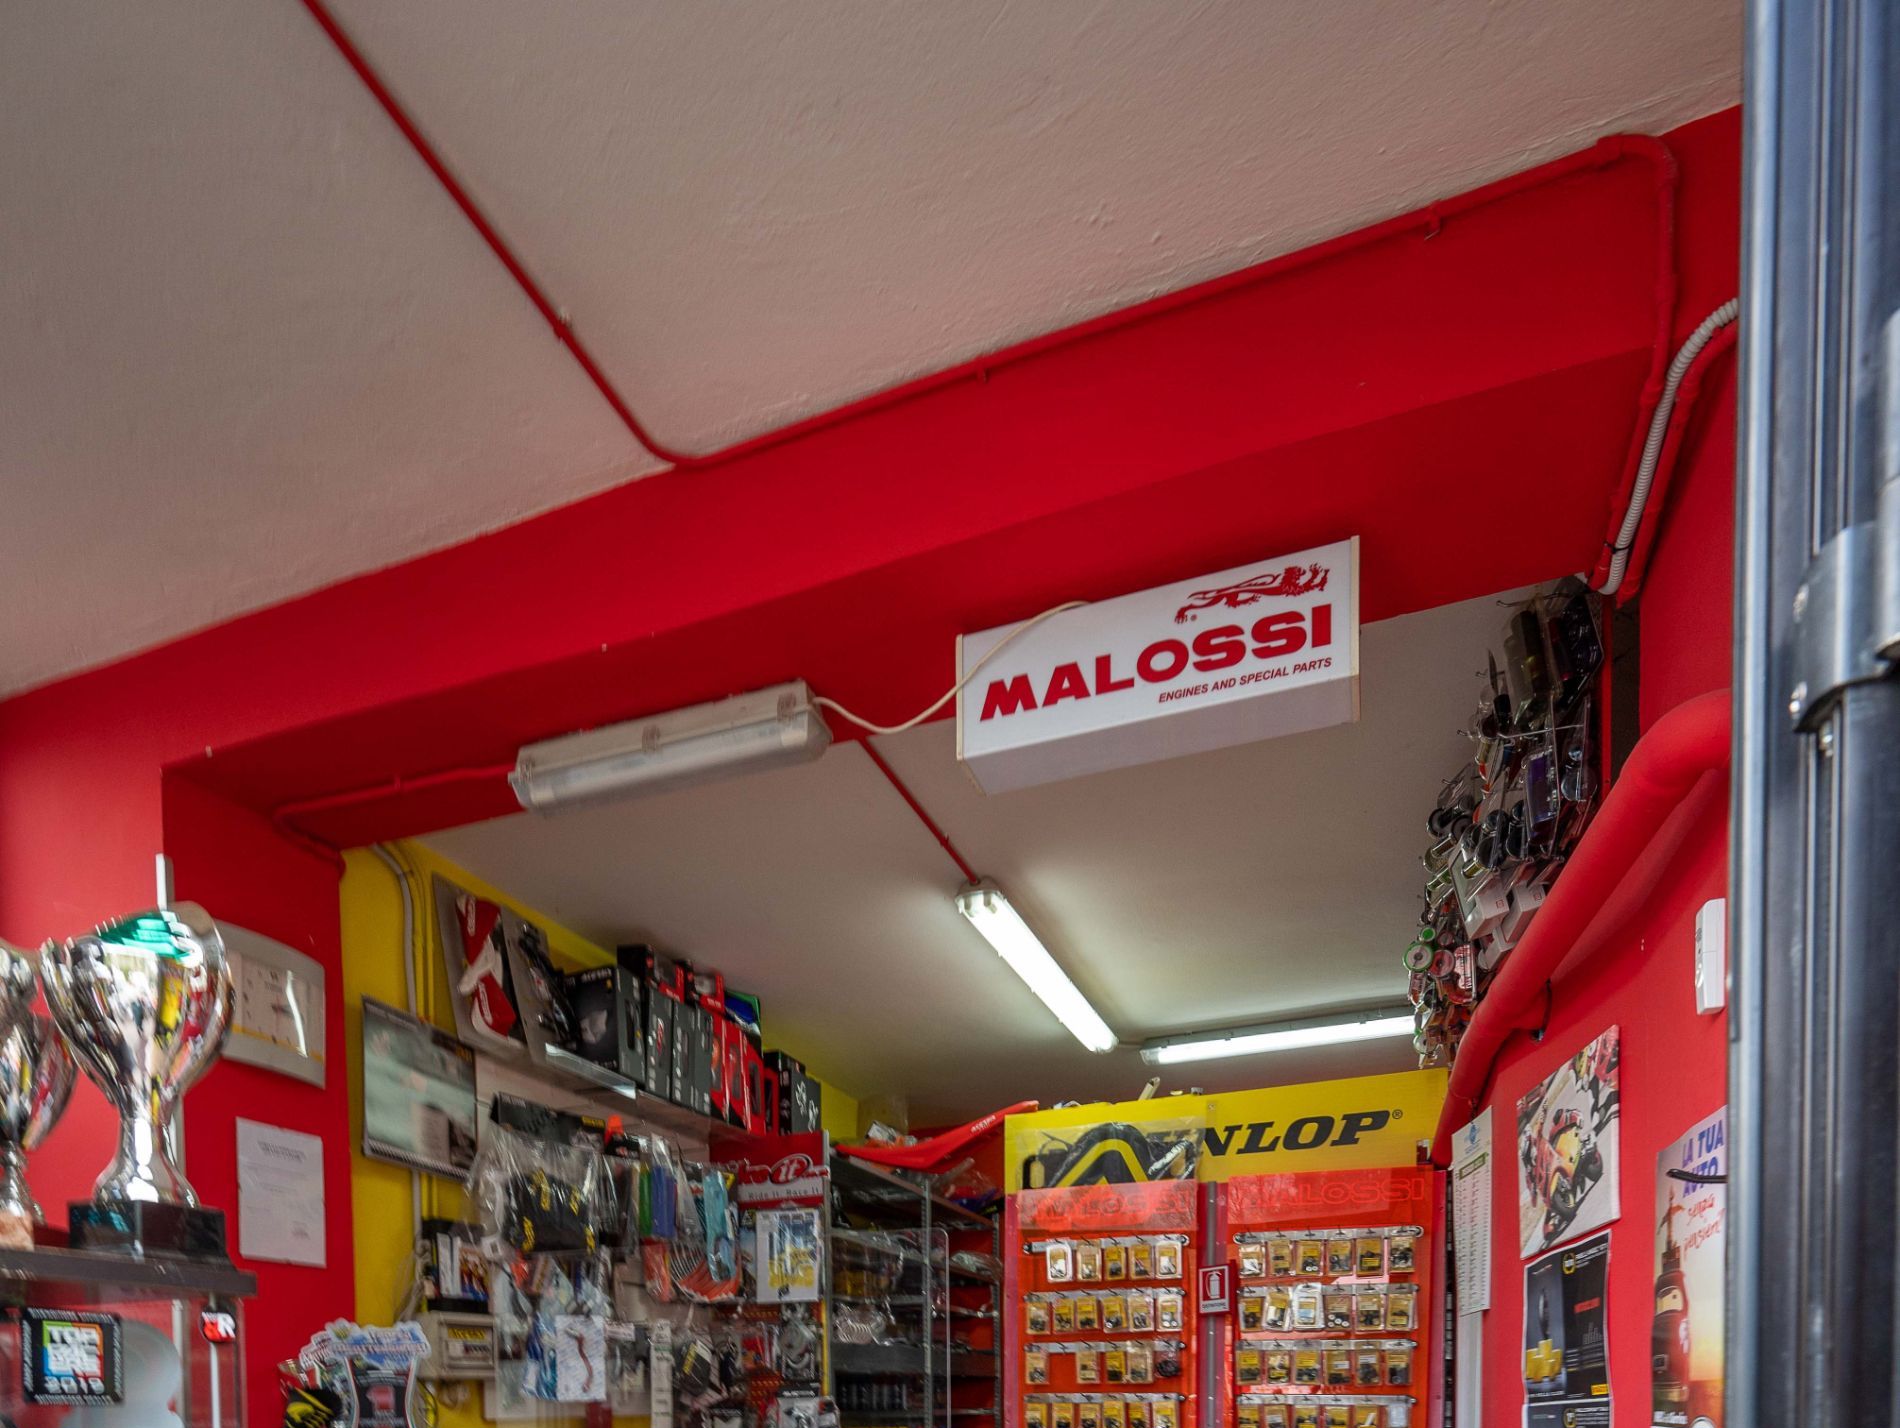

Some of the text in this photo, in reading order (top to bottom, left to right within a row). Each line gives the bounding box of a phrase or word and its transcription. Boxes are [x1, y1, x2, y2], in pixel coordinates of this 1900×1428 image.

[980, 603, 1332, 722] MALOSSI
[1158, 657, 1332, 703] ENGINES AND SPECIAL PARTS
[1150, 1109, 1391, 1158] NLOP
[1682, 1120, 1725, 1169] LA TUA
